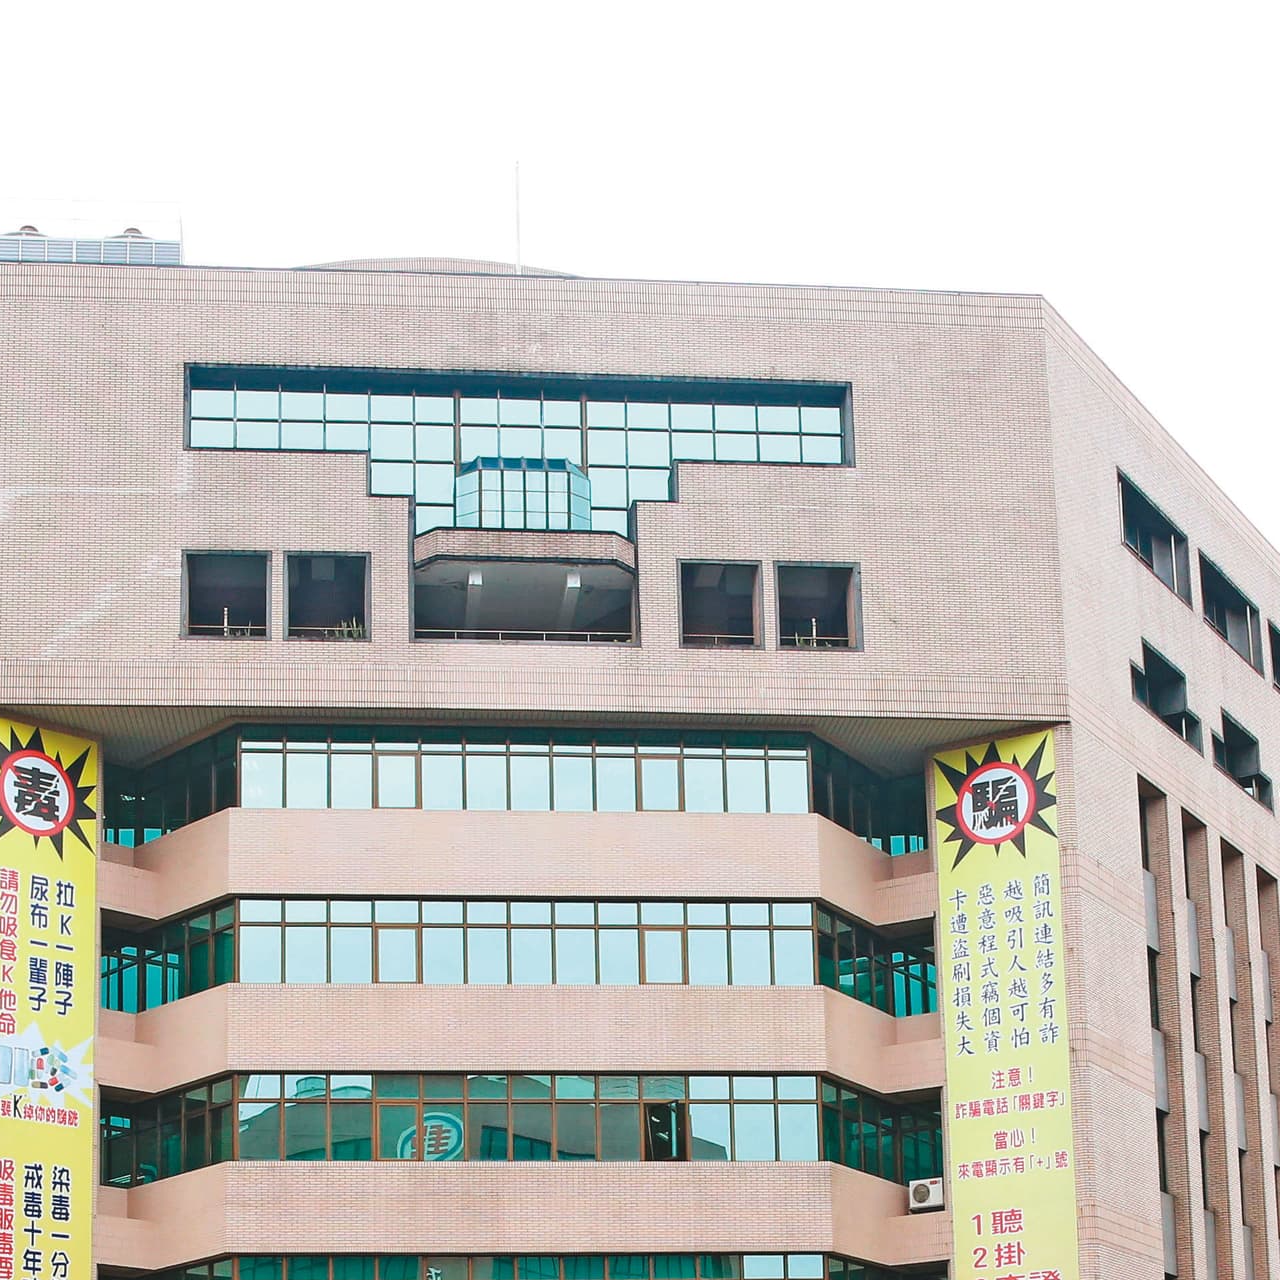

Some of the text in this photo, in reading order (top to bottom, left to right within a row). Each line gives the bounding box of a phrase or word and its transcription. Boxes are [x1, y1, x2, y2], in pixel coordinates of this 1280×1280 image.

[14, 766, 59, 822] 毒
[971, 776, 1019, 831] 騙
[29, 875, 48, 1011] 尿布一輩子
[55, 881, 74, 1015] 拉K一陣子
[949, 889, 976, 1057] 卡遭盜刷損失大
[976, 884, 1001, 1053] 惡意程式竊個資
[1003, 880, 1030, 1049] 越吸引人越可怕
[1032, 873, 1059, 1045] 簡訊連結多有詐
[955, 1090, 1066, 1119] 詐騙電話「關鍵字」
[971, 1208, 1024, 1236] 1 聽
[973, 1241, 1026, 1268] 2 掛
